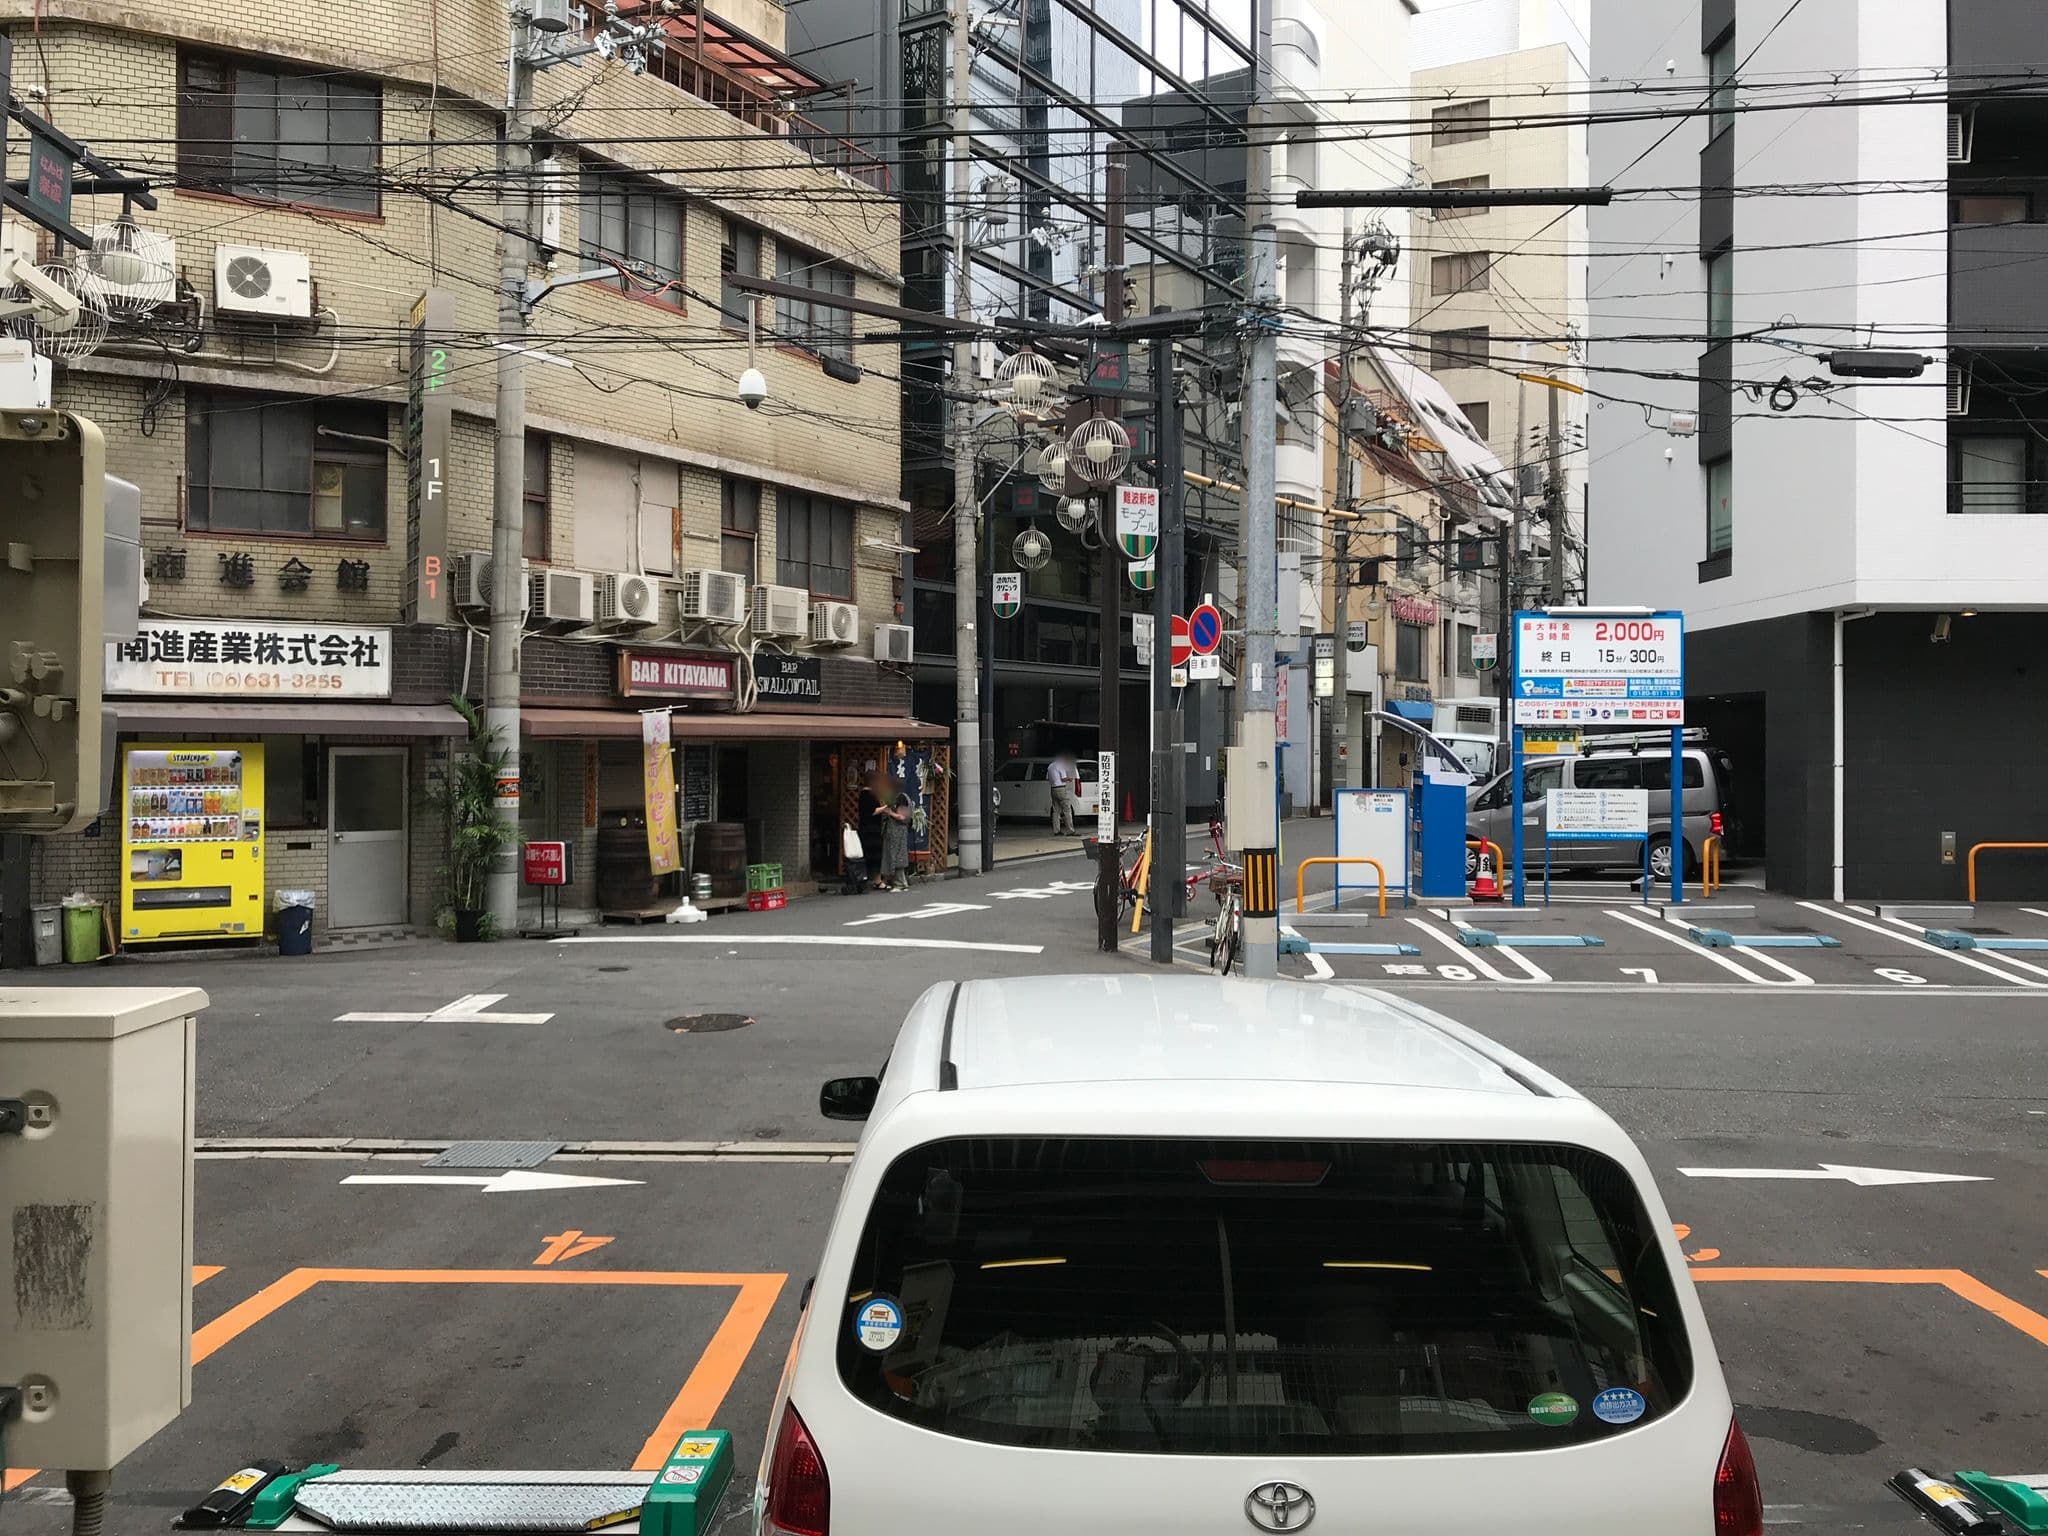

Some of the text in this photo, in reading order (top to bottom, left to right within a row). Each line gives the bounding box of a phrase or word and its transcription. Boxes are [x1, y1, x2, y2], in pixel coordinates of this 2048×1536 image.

[431, 350, 446, 391] 2F
[427, 458, 444, 501] 1F
[1121, 507, 1153, 519] モーター
[424, 556, 441, 600] B1
[1523, 622, 1665, 642] 最大料金 2,000円
[116, 629, 381, 667] 南進産業株式会社
[1541, 651, 1571, 663] 終日
[781, 661, 798, 673] BAR
[1191, 658, 1218, 669] 自動車
[631, 660, 727, 688] BAR KITAYAMA
[757, 676, 821, 696] SWALLOWTAIL
[1101, 755, 1111, 812] 防犯カメラ作動中
[1436, 964, 1478, 981] 8
[1619, 967, 1659, 983] 7
[1873, 968, 1929, 984] 6
[532, 1230, 616, 1265] 4
